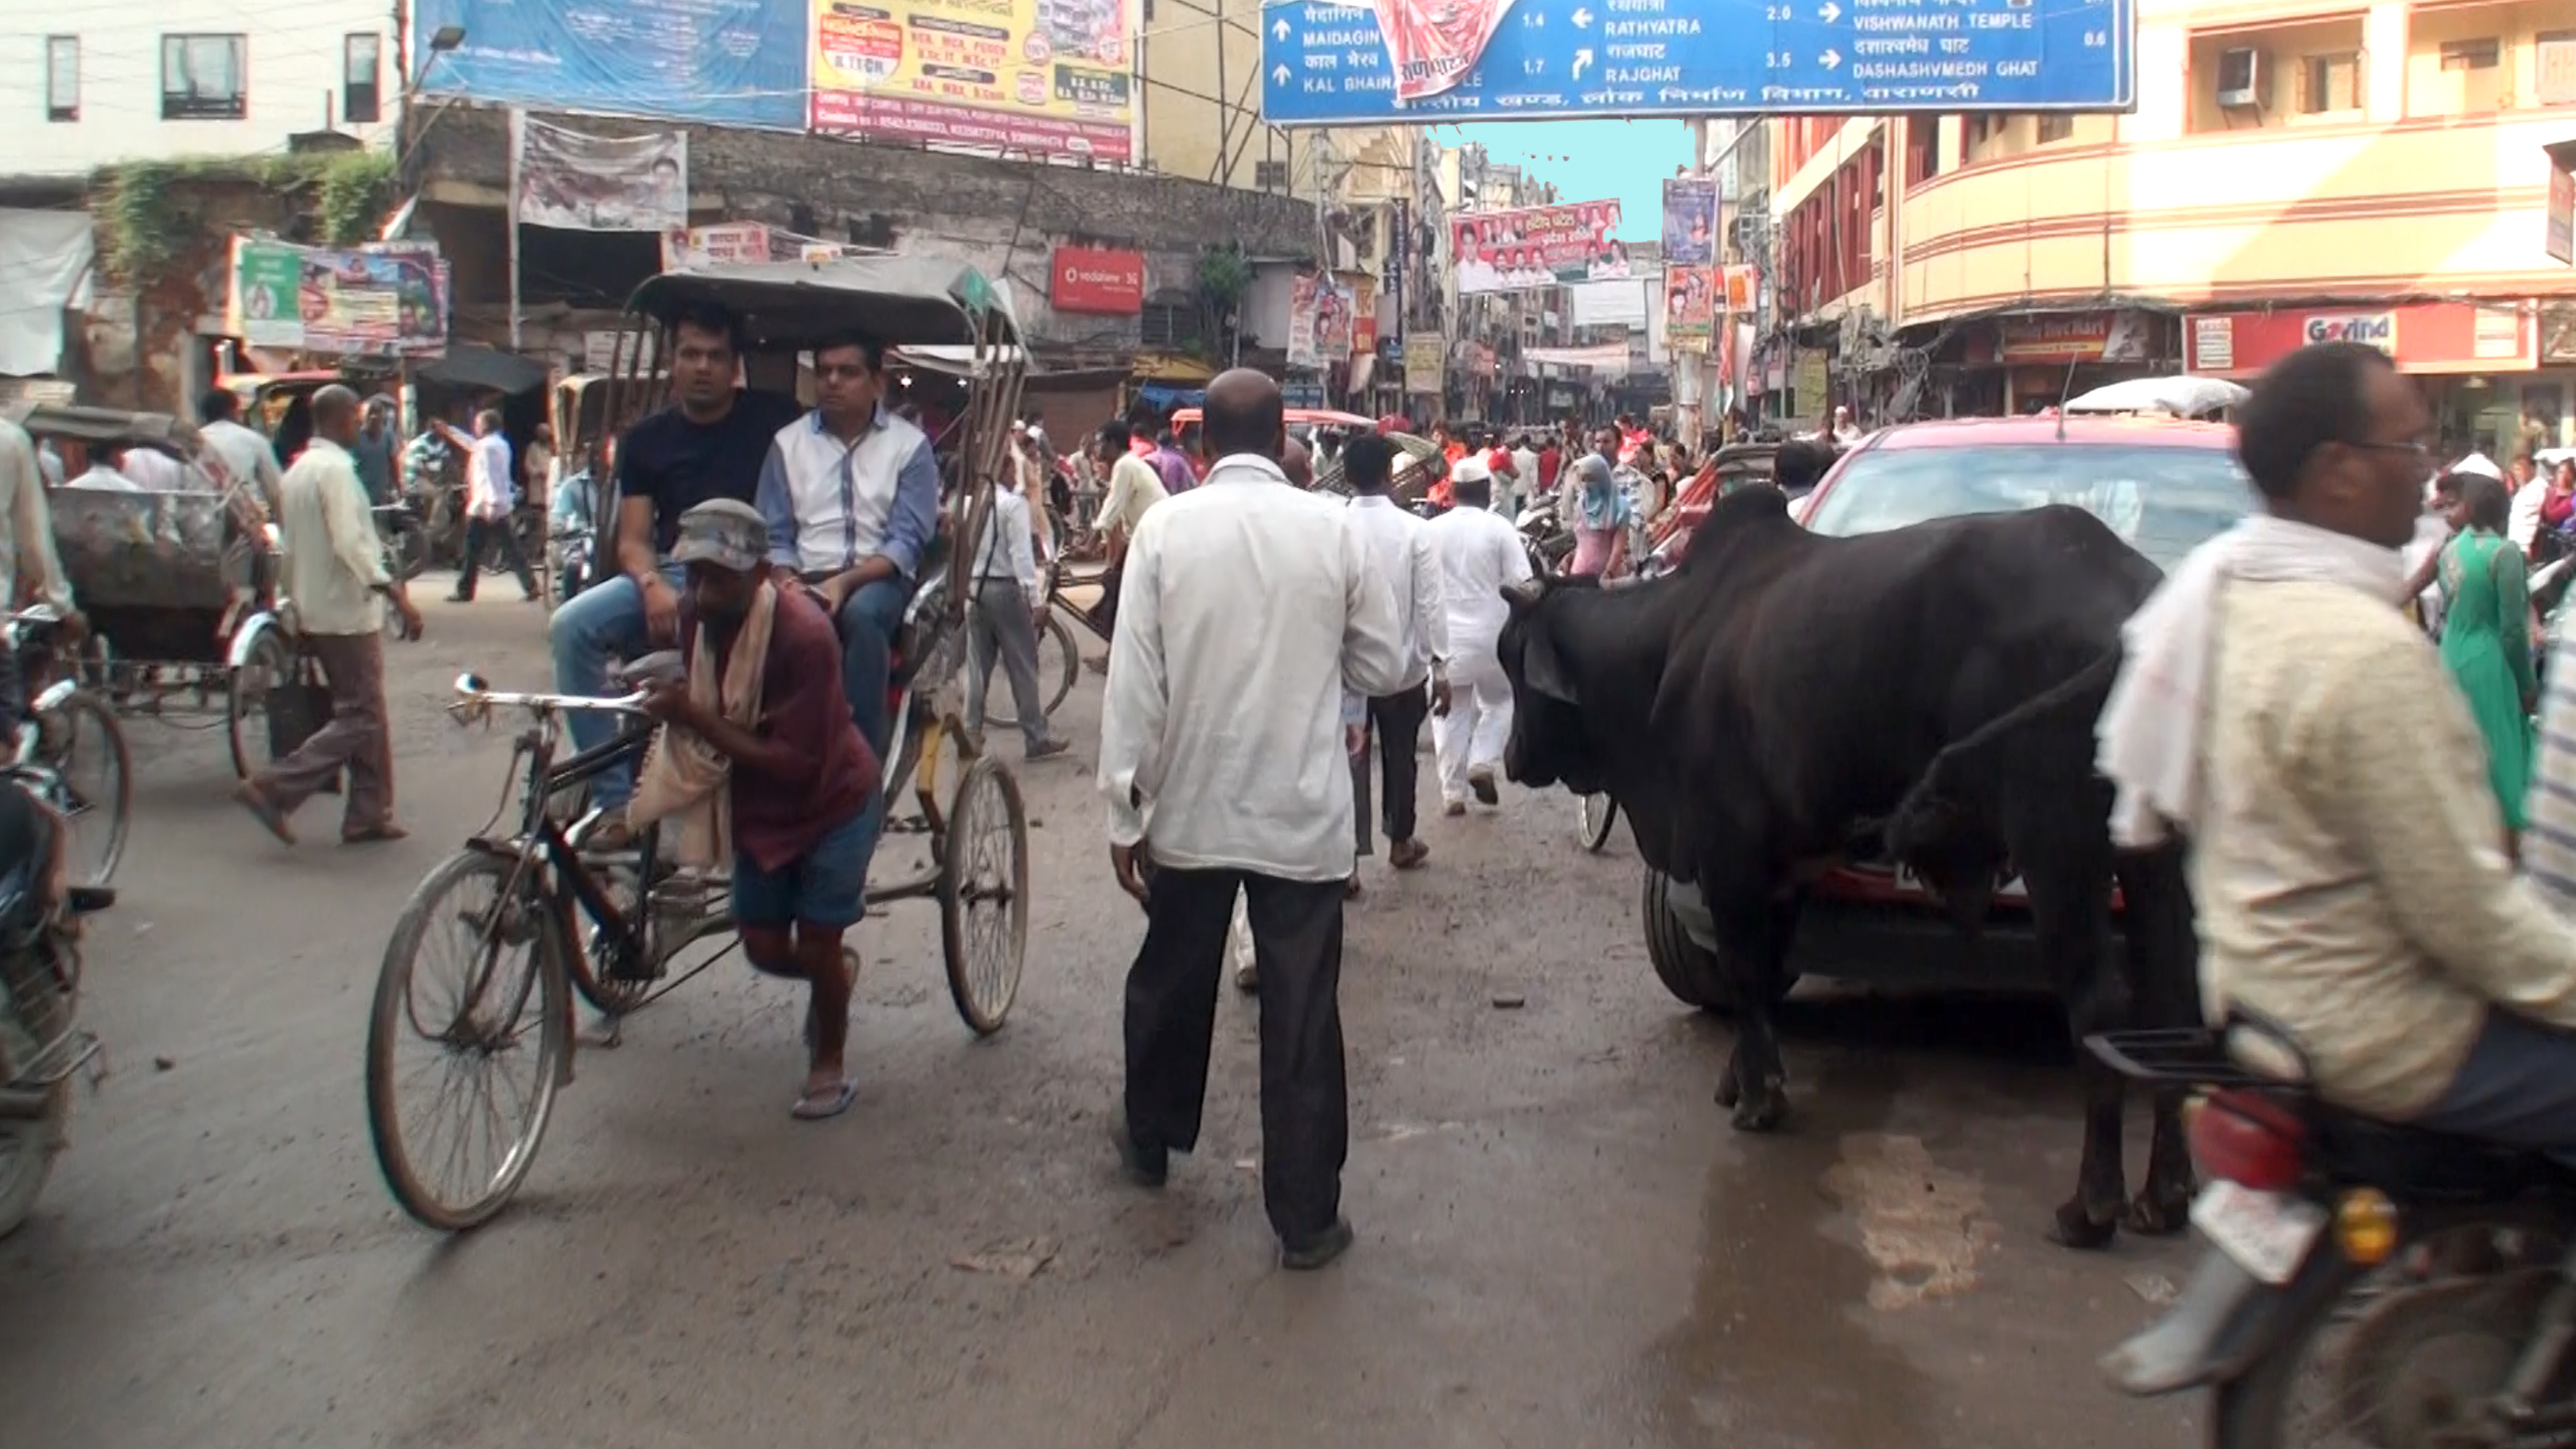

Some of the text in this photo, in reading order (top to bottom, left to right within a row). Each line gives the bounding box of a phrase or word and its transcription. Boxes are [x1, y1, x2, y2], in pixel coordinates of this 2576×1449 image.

[1605, 18, 1701, 37] RATHYATRA
[1853, 14, 2033, 31] VISHWANATH TEMPLE
[1303, 30, 1379, 46] MAIDAGIN
[1605, 66, 1680, 82] RAJGHAT
[1996, 60, 2037, 76] GHAT
[1303, 75, 1395, 92] KAL BHAIR
